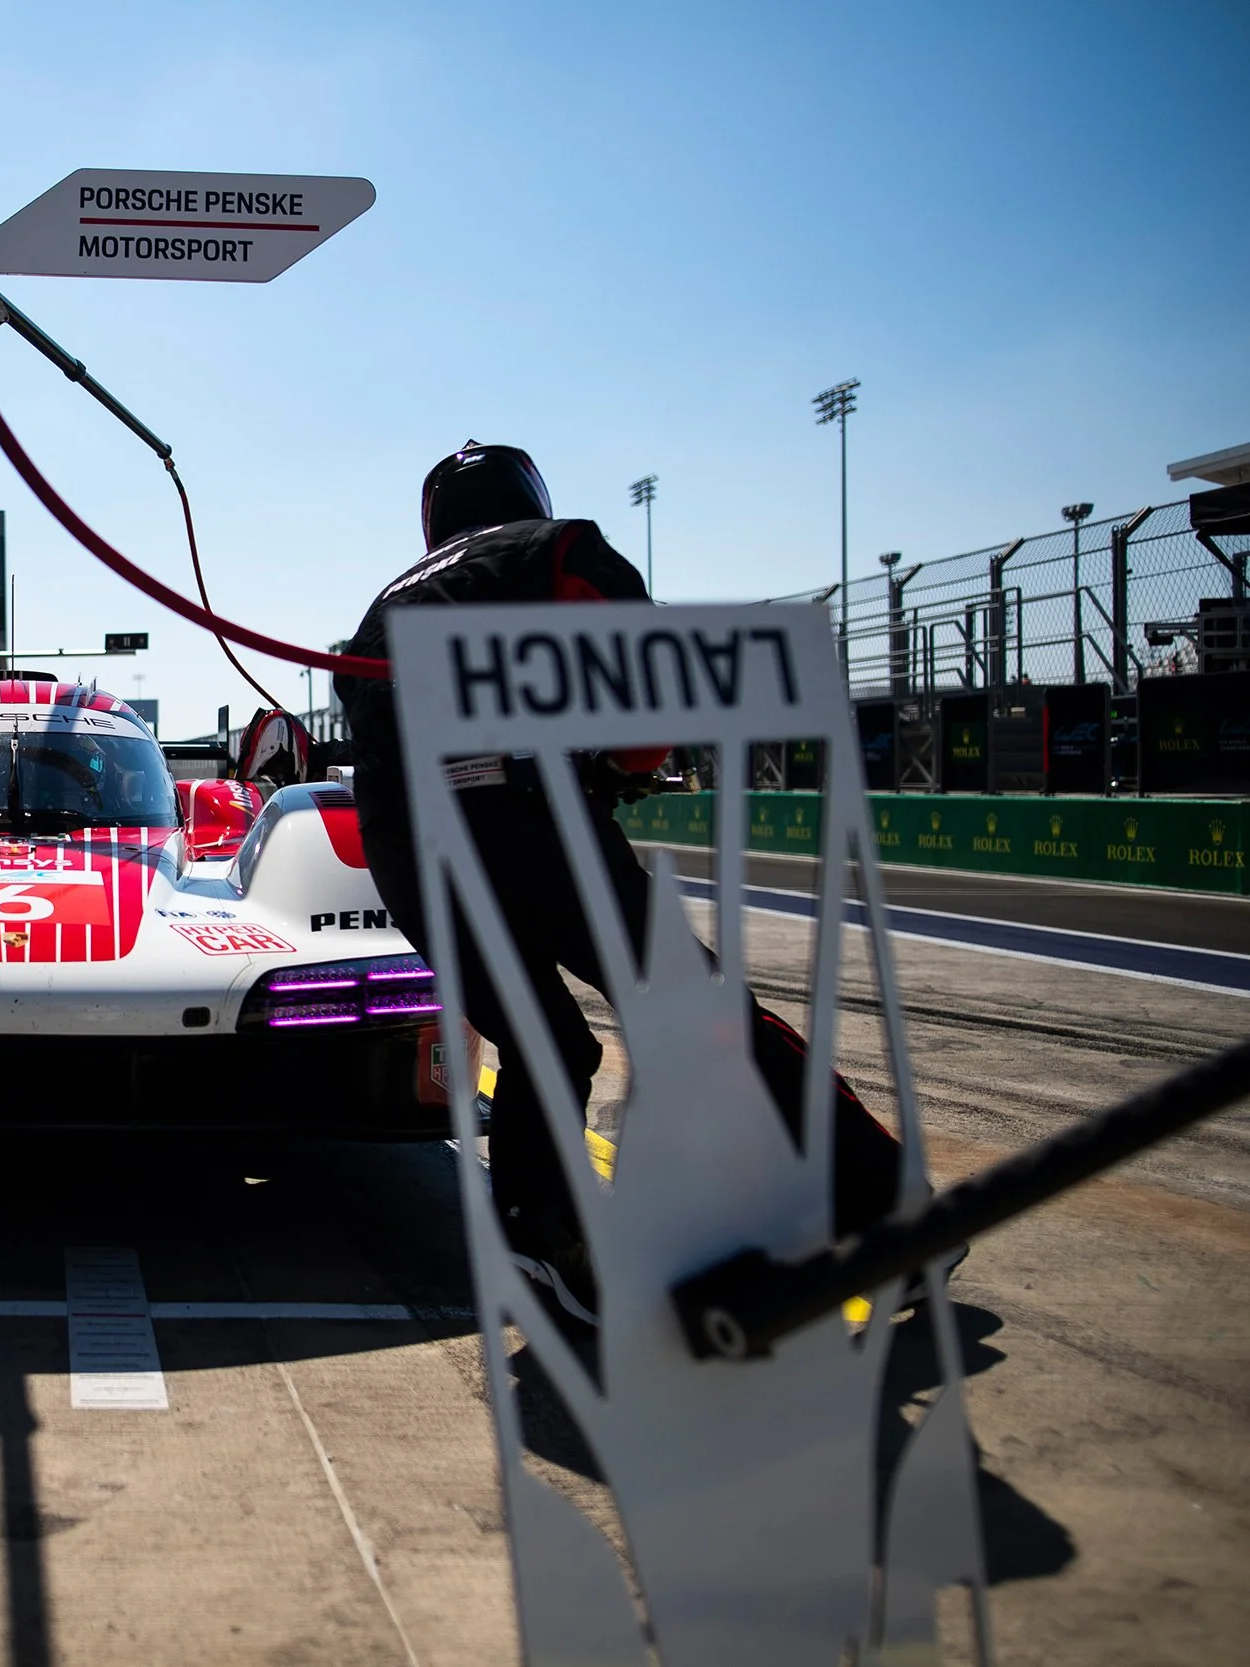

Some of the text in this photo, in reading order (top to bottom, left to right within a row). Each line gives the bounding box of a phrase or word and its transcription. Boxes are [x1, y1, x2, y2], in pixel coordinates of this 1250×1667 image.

[79, 186, 304, 216] PORSCHE PENSKE
[78, 235, 254, 263] MOTORSPORT
[447, 627, 801, 721] LAUNCH
[953, 745, 982, 757] ROLEX
[1158, 738, 1202, 751] ROLEX
[918, 833, 954, 849] ROLEX
[973, 836, 1011, 853] ROLEX
[1033, 839, 1078, 858] ROLEX
[1106, 844, 1156, 863] ROLEX
[1188, 848, 1246, 869] ROLEX
[311, 909, 400, 932] PEN
[179, 925, 265, 936] HYPER
[196, 934, 286, 952] CAR
